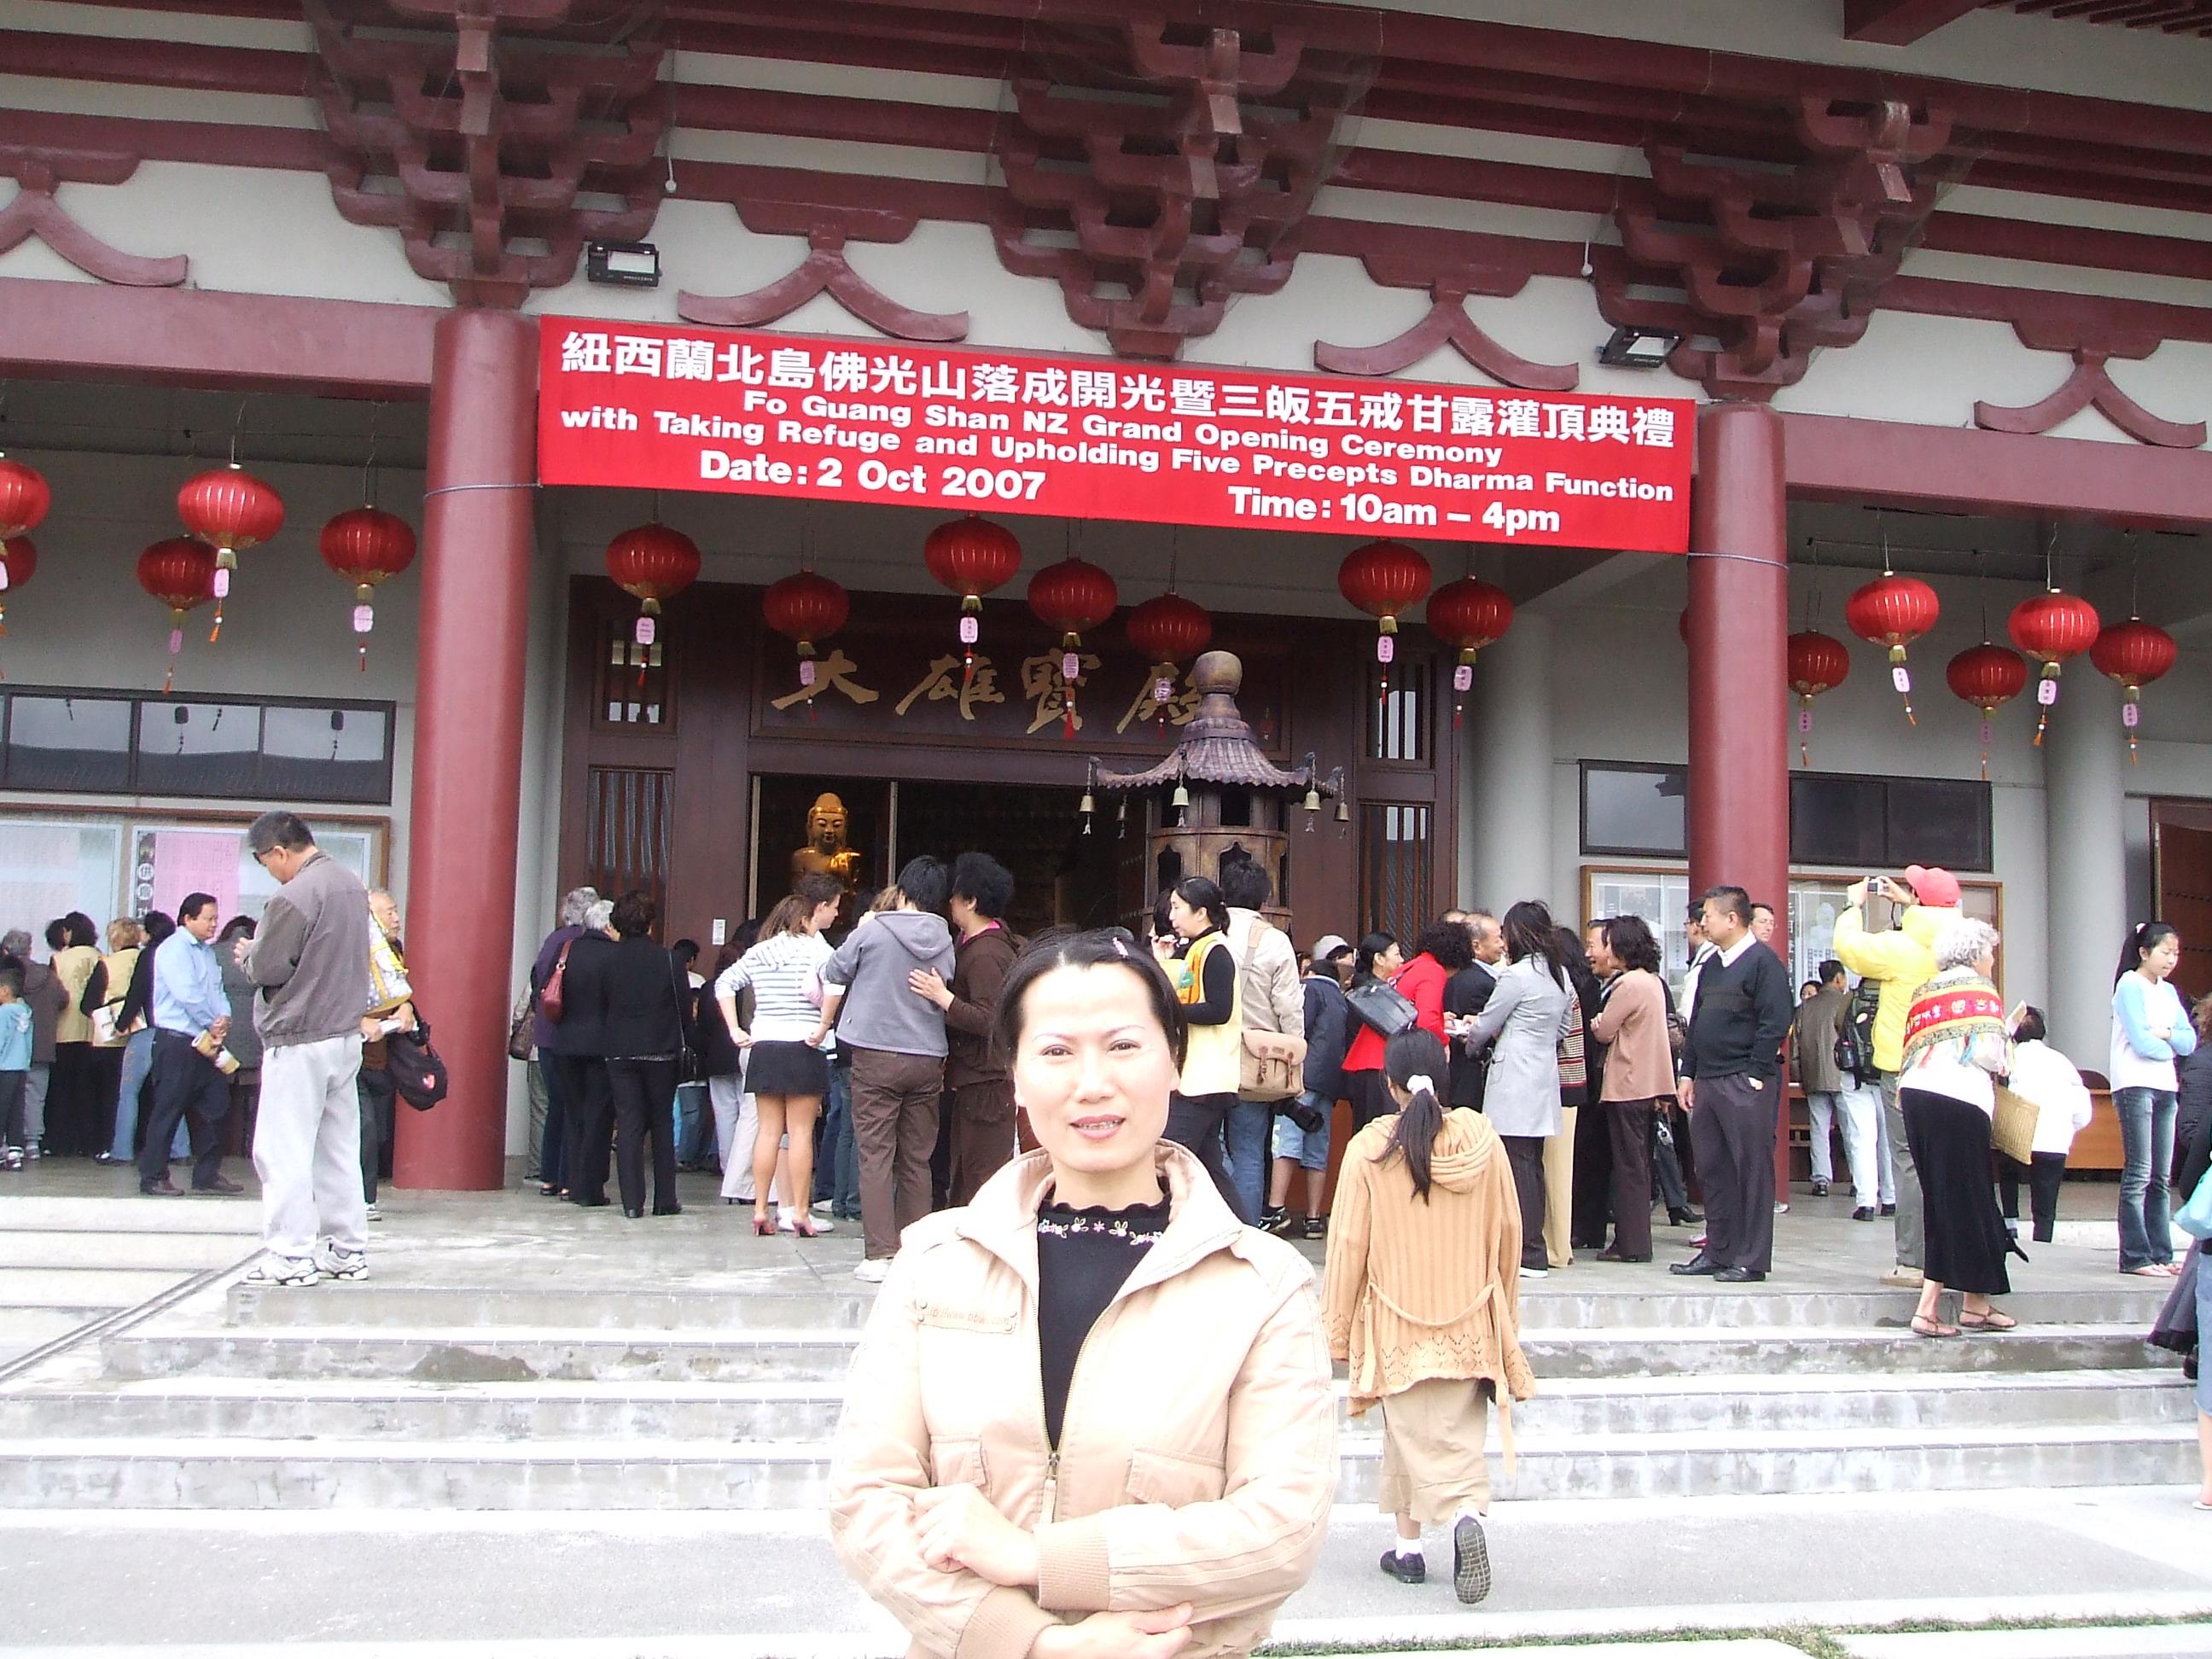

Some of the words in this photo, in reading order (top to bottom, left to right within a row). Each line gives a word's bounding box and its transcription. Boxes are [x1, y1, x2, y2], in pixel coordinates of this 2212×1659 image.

[561, 331, 1674, 448] 紐西蘭北島佛光山落成開光暨三皈五戒甘露灌頂典禮
[743, 389, 788, 415] Fo
[801, 394, 911, 428] Guang
[924, 404, 1010, 431] Shan
[1022, 410, 1068, 435] NZ
[1082, 414, 1182, 442] Grand
[1194, 421, 1329, 459] Opening
[1341, 434, 1503, 468] Ceremony
[561, 405, 638, 431] with
[653, 410, 765, 446] Taking
[777, 419, 901, 454] Refuge
[915, 434, 978, 457] and
[991, 435, 1160, 473] Upholding
[1172, 447, 1241, 474] Five
[1252, 454, 1398, 487] Precepts
[1410, 465, 1534, 493] Dharma
[1545, 471, 1674, 502] Function
[816, 457, 843, 487] 2
[857, 459, 927, 494] Oct
[940, 466, 1046, 500] 2007
[1340, 492, 1437, 526] 10am
[1481, 501, 1560, 537] 4pm
